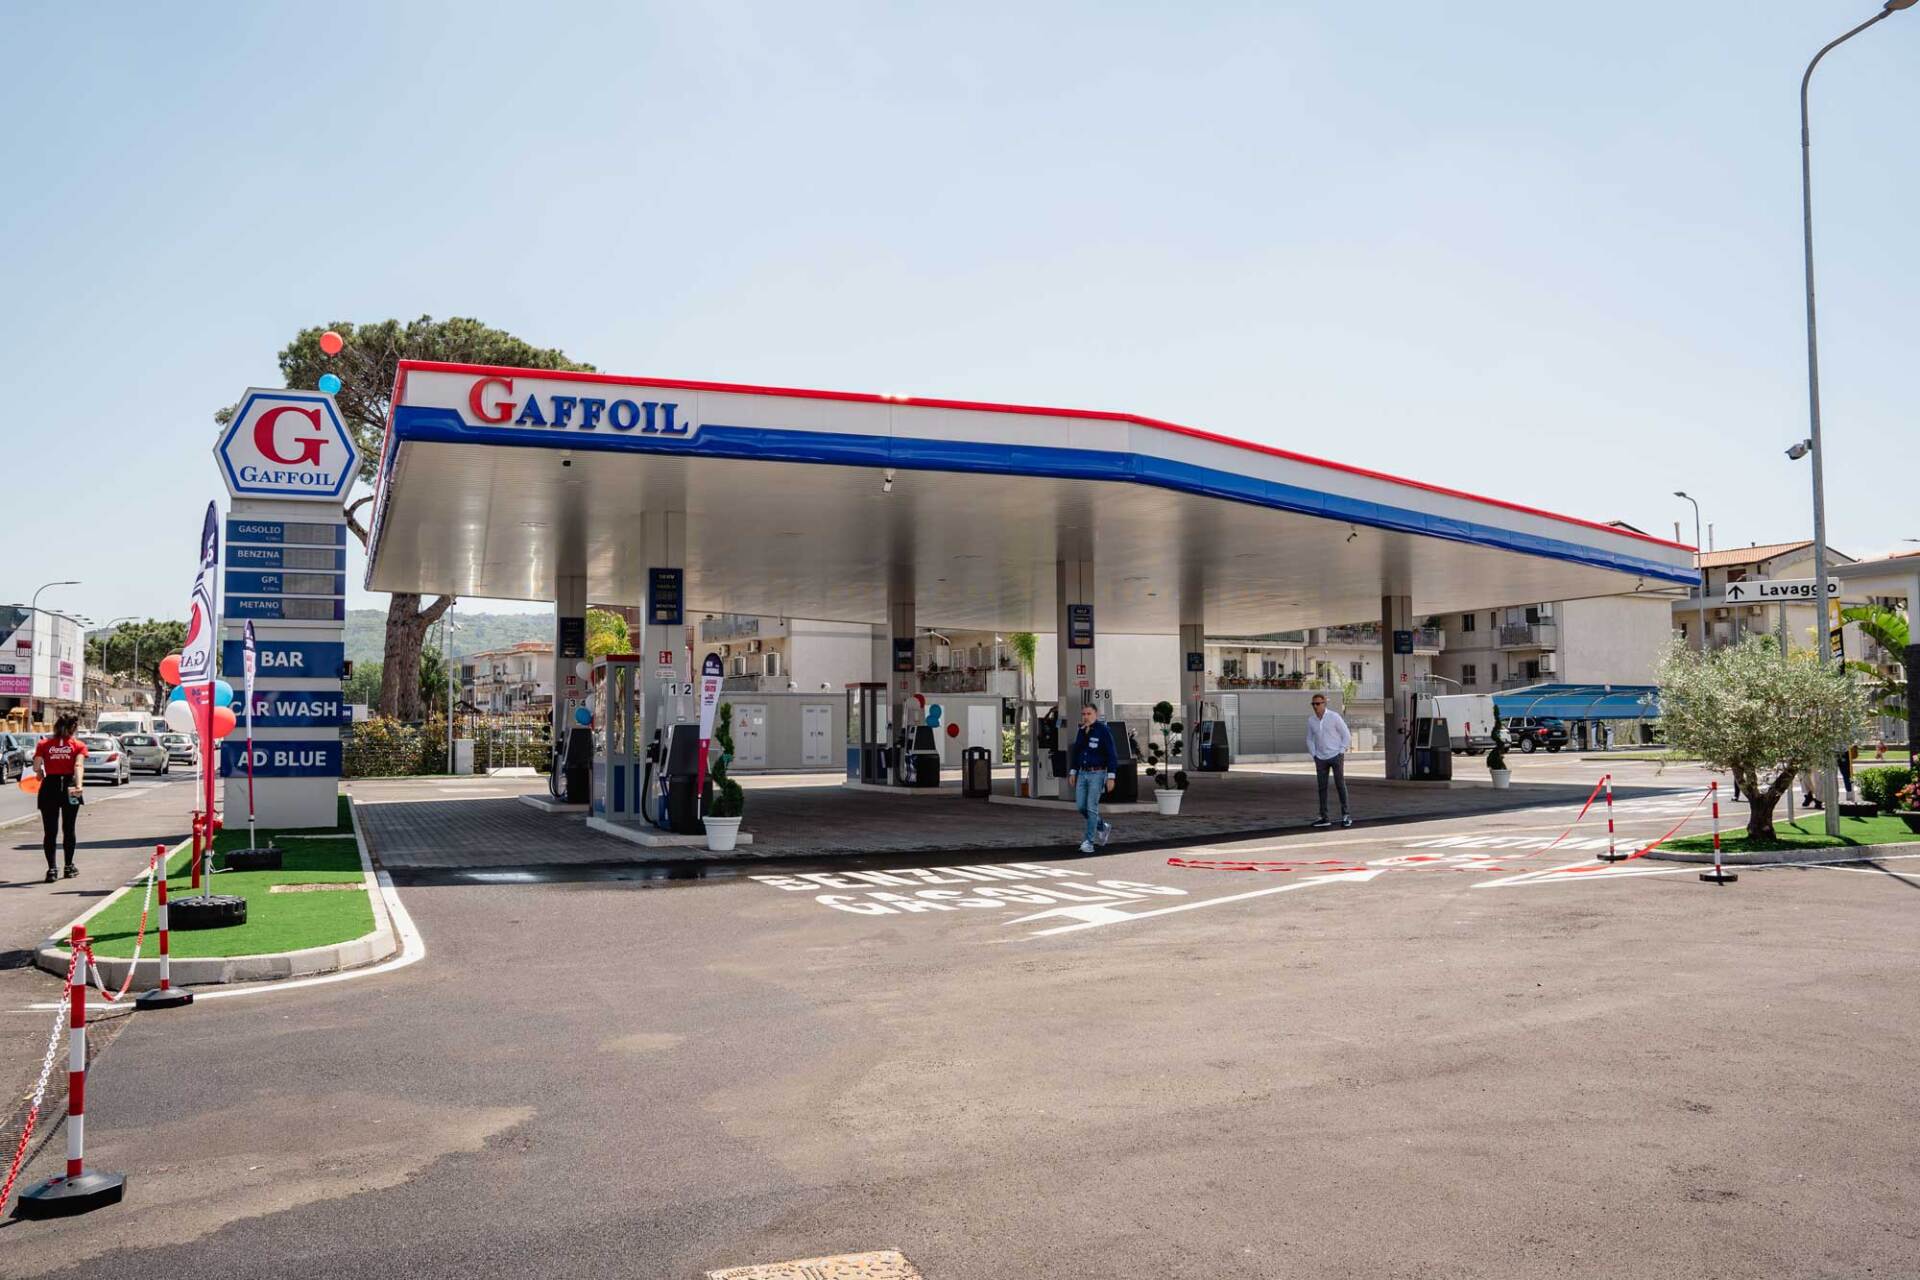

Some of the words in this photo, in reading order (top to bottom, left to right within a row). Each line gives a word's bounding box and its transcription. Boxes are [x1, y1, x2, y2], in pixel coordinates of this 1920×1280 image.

[469, 376, 689, 435] GAFFOIL
[254, 406, 329, 467] G
[240, 466, 335, 486] GAFFOIL
[239, 525, 280, 534] GASOLIO
[238, 550, 279, 558] BENZINA
[261, 576, 279, 584] GPL
[1760, 583, 1837, 597] Lavaggo
[240, 601, 279, 609] METANO
[261, 651, 304, 667] BAR
[670, 684, 676, 695] 1
[684, 684, 692, 695] 2
[1095, 690, 1100, 699] 5
[1104, 690, 1110, 699] 6
[229, 701, 270, 716] CAR
[276, 701, 337, 717] WASH
[570, 699, 576, 707] 3
[580, 699, 586, 707] 4
[237, 751, 268, 767] AD
[274, 751, 327, 767] BLUE
[748, 862, 1094, 891] BENZINA
[815, 879, 1189, 916] GASOLIO
